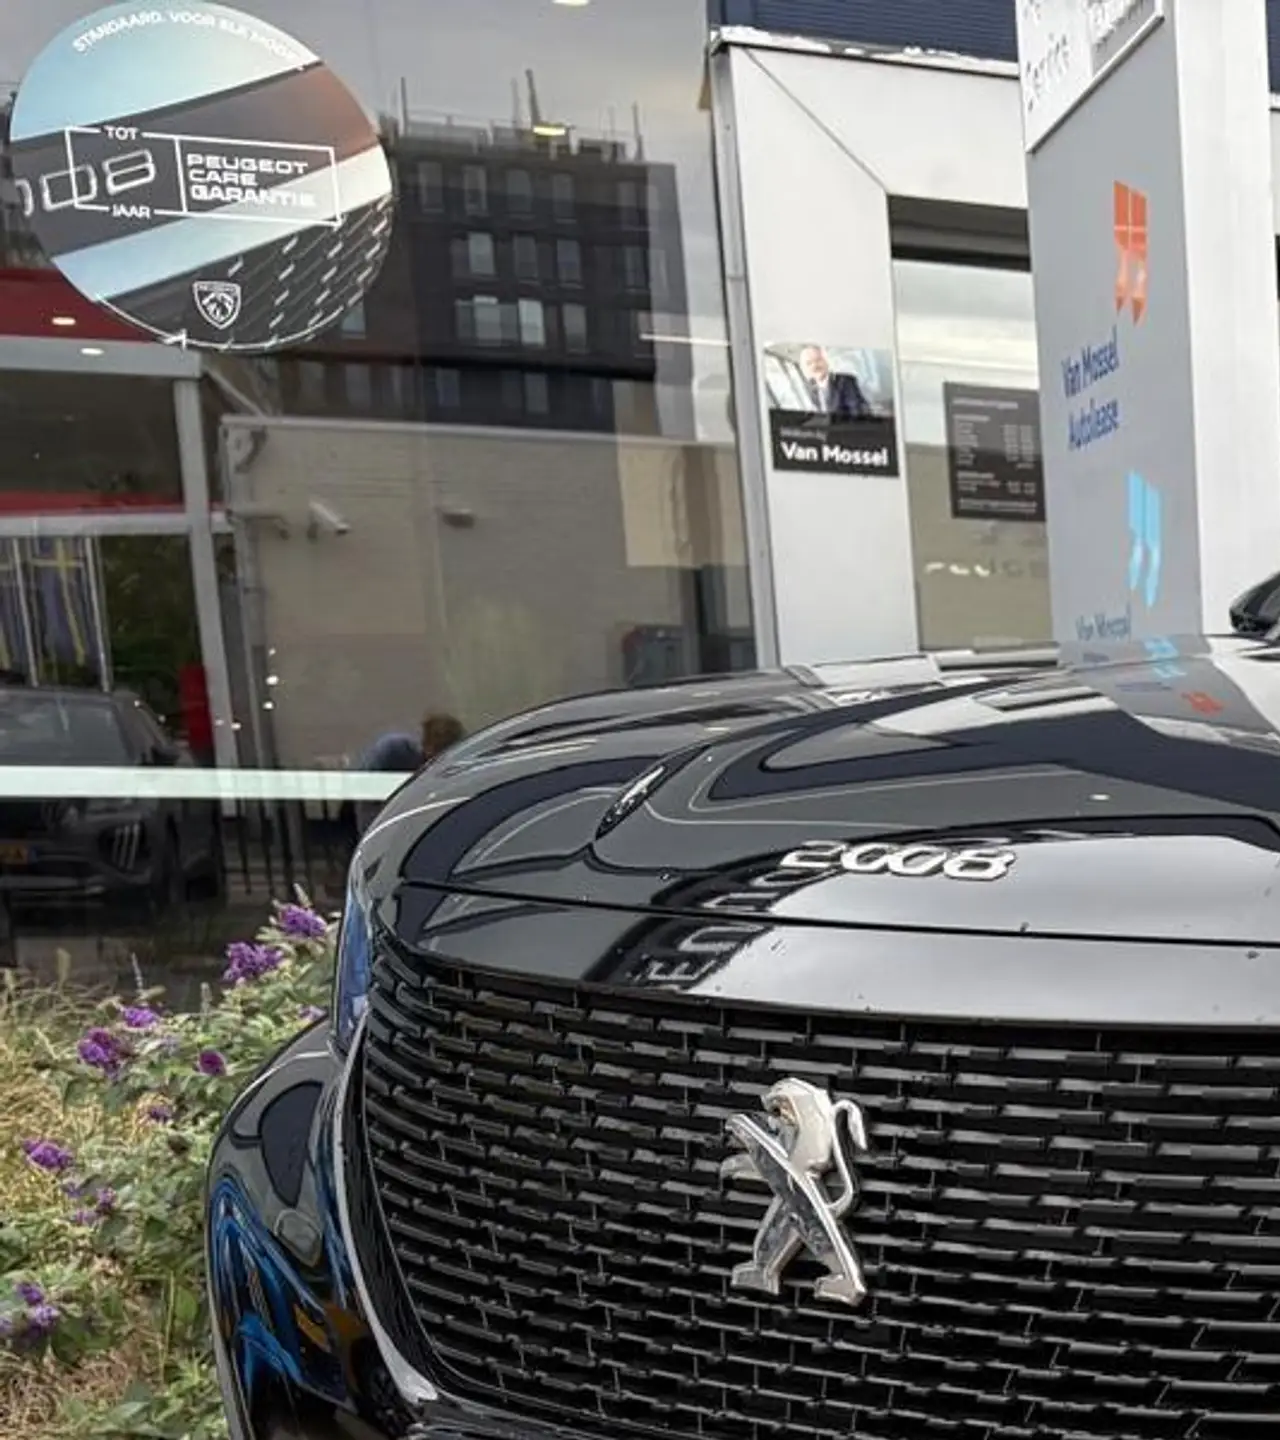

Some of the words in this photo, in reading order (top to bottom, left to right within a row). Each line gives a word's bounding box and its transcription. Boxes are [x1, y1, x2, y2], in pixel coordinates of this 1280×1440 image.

[105, 126, 139, 141] TOT
[187, 153, 308, 174] PEUGEOT
[189, 171, 259, 186] CARE
[190, 184, 317, 208] GARANTIE
[112, 203, 151, 219] JAAR
[1061, 356, 1081, 399] Van
[780, 441, 818, 461] Van
[822, 443, 889, 468] Mossel
[779, 839, 1016, 881] 2008
